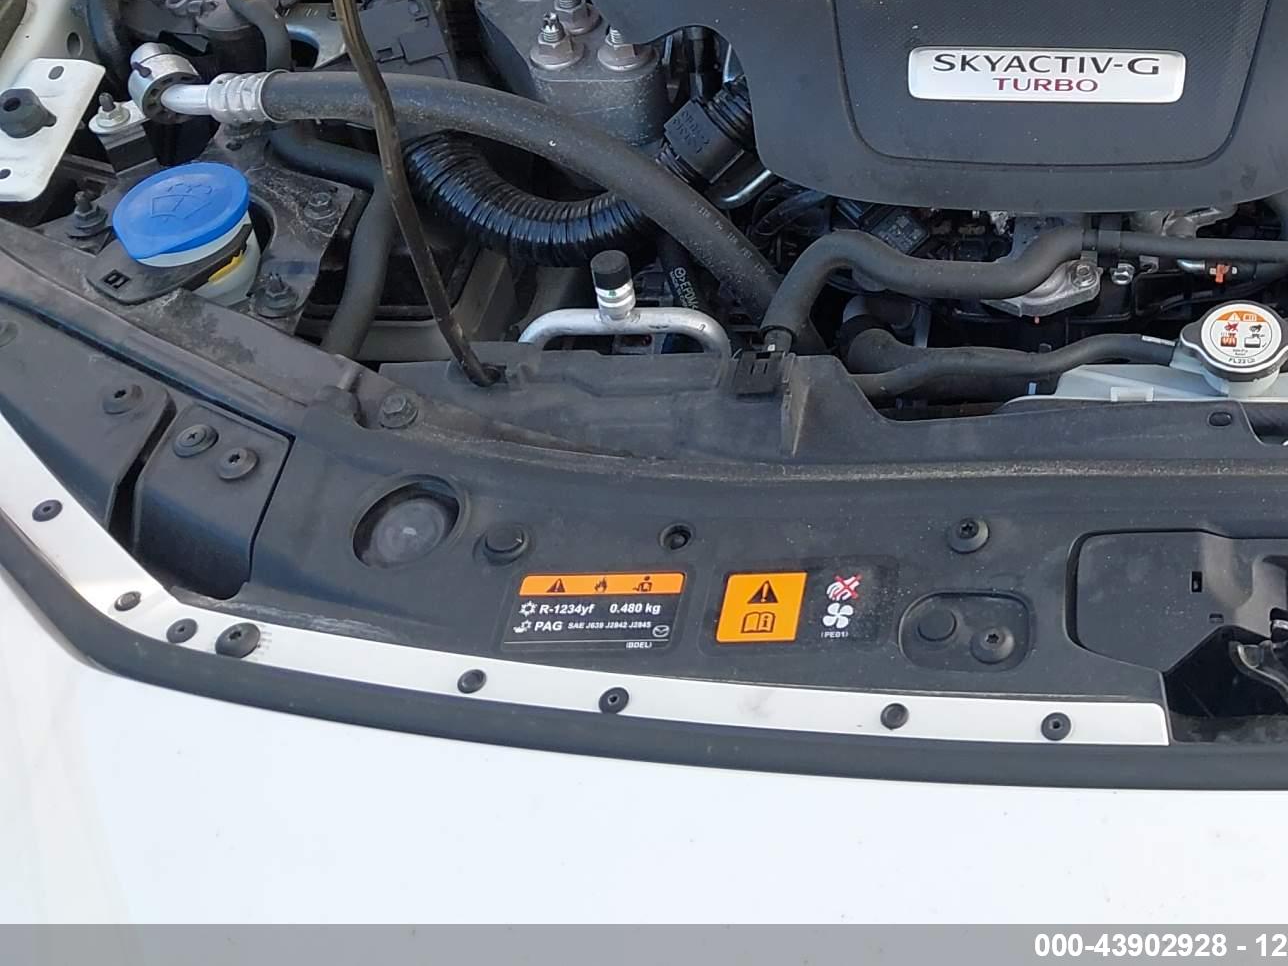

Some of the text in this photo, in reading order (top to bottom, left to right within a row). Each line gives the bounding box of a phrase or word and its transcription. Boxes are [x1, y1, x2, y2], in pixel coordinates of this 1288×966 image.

[932, 53, 1160, 75] SKYACTIV-G
[993, 77, 1098, 92] TURBO
[539, 603, 661, 617] R-1234yf 0.480 kg
[534, 621, 563, 631] PAG
